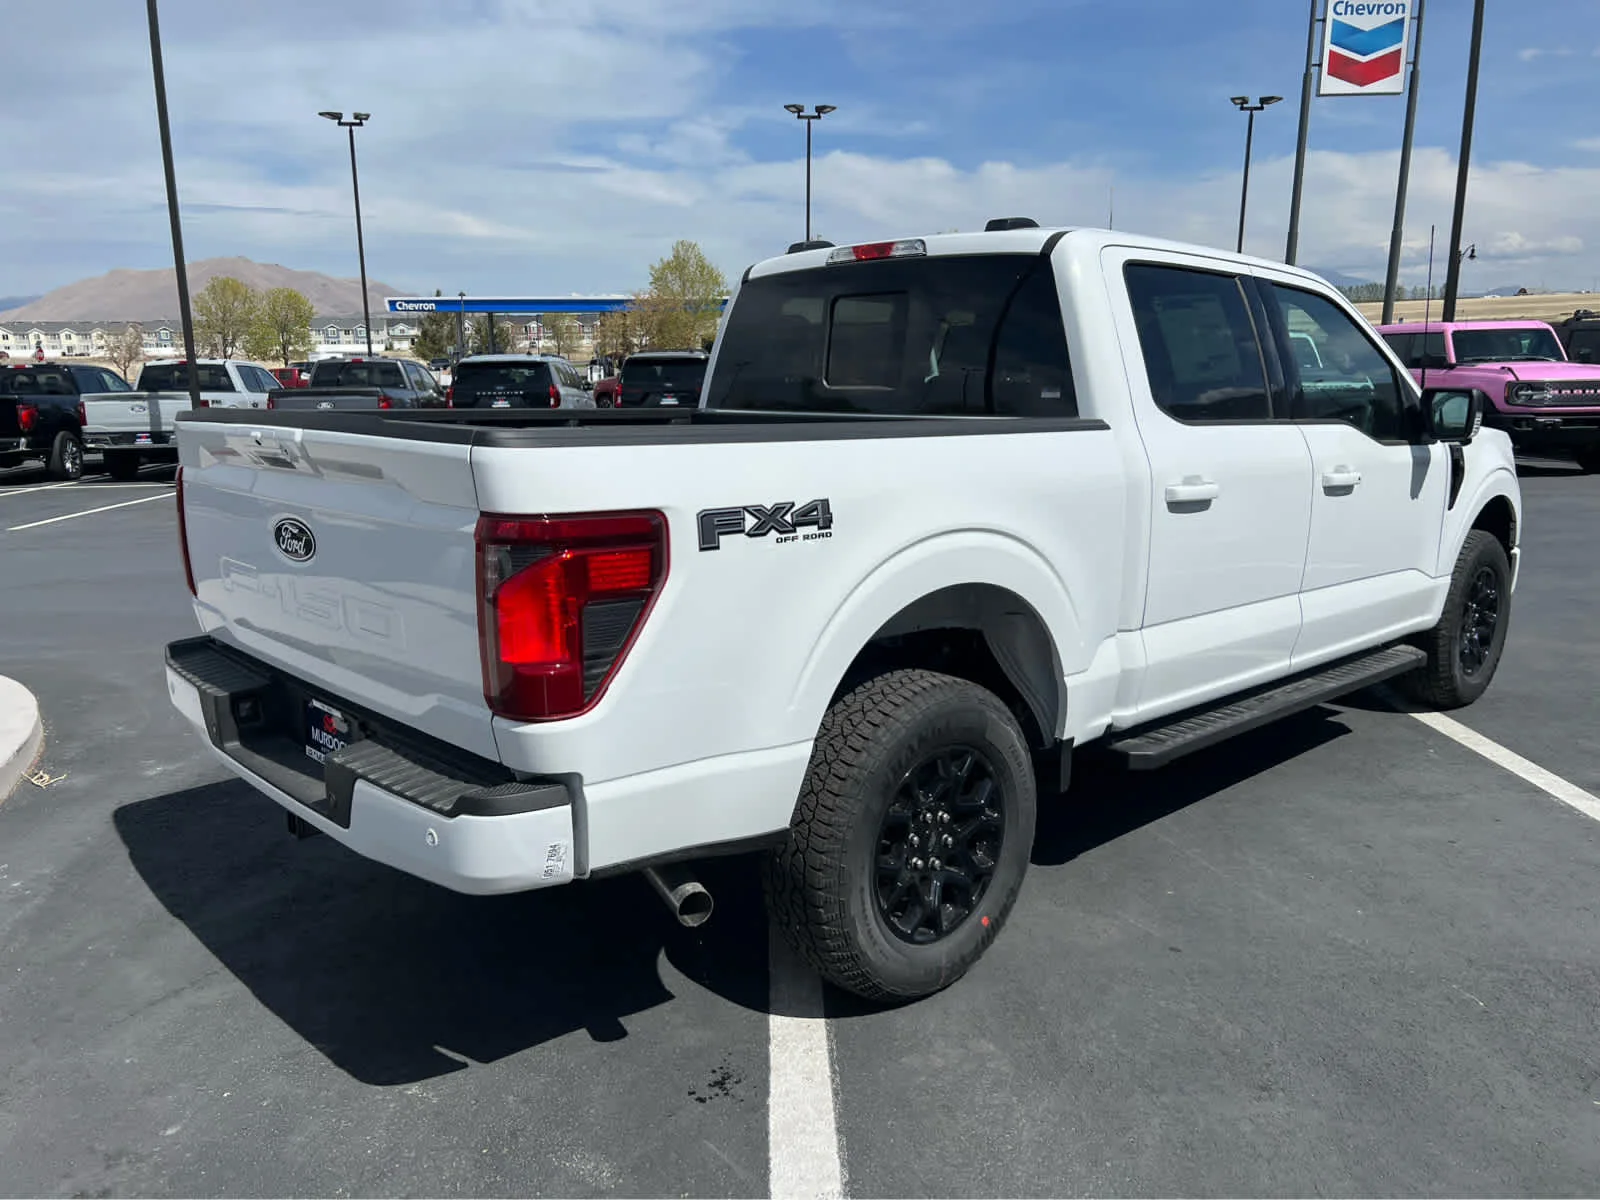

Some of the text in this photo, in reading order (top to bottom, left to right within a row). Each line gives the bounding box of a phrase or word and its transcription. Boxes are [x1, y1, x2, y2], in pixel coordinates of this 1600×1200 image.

[1333, 1, 1406, 15] Chevron
[395, 301, 436, 311] Chevron
[696, 498, 833, 552] FX4
[280, 524, 306, 555] Ford
[776, 531, 833, 544] OFF ROAD
